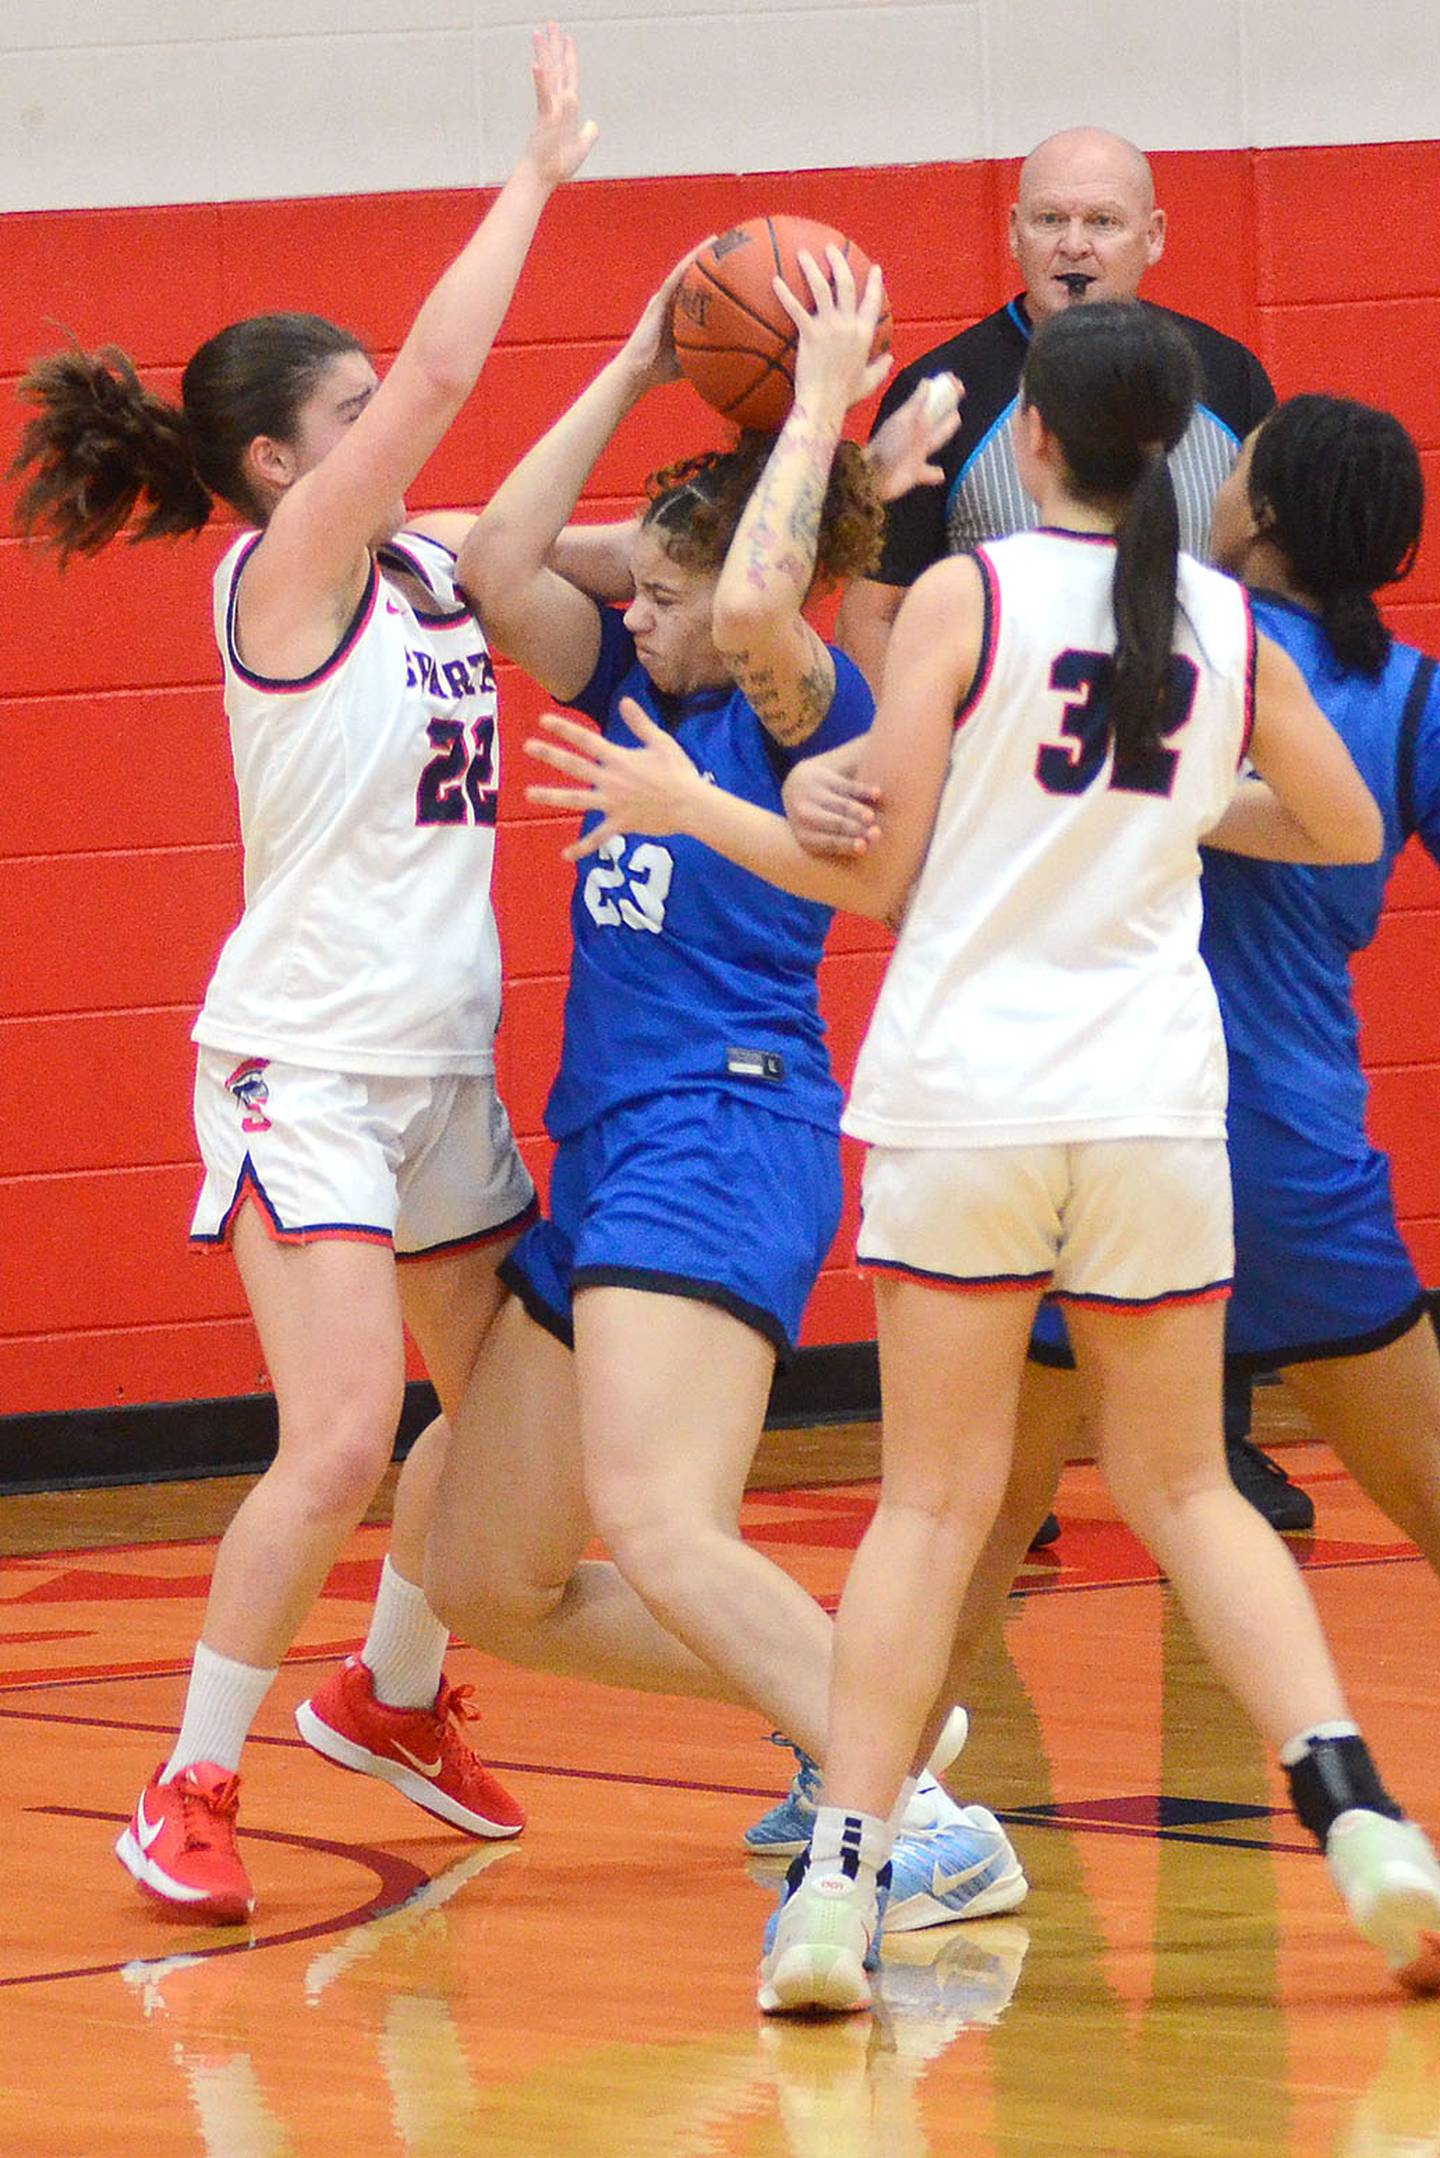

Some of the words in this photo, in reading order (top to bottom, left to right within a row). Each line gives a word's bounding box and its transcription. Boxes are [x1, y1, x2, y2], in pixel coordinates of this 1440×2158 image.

[415, 715, 499, 826] 22
[1034, 648, 1200, 800] 32
[584, 834, 674, 934] 23
